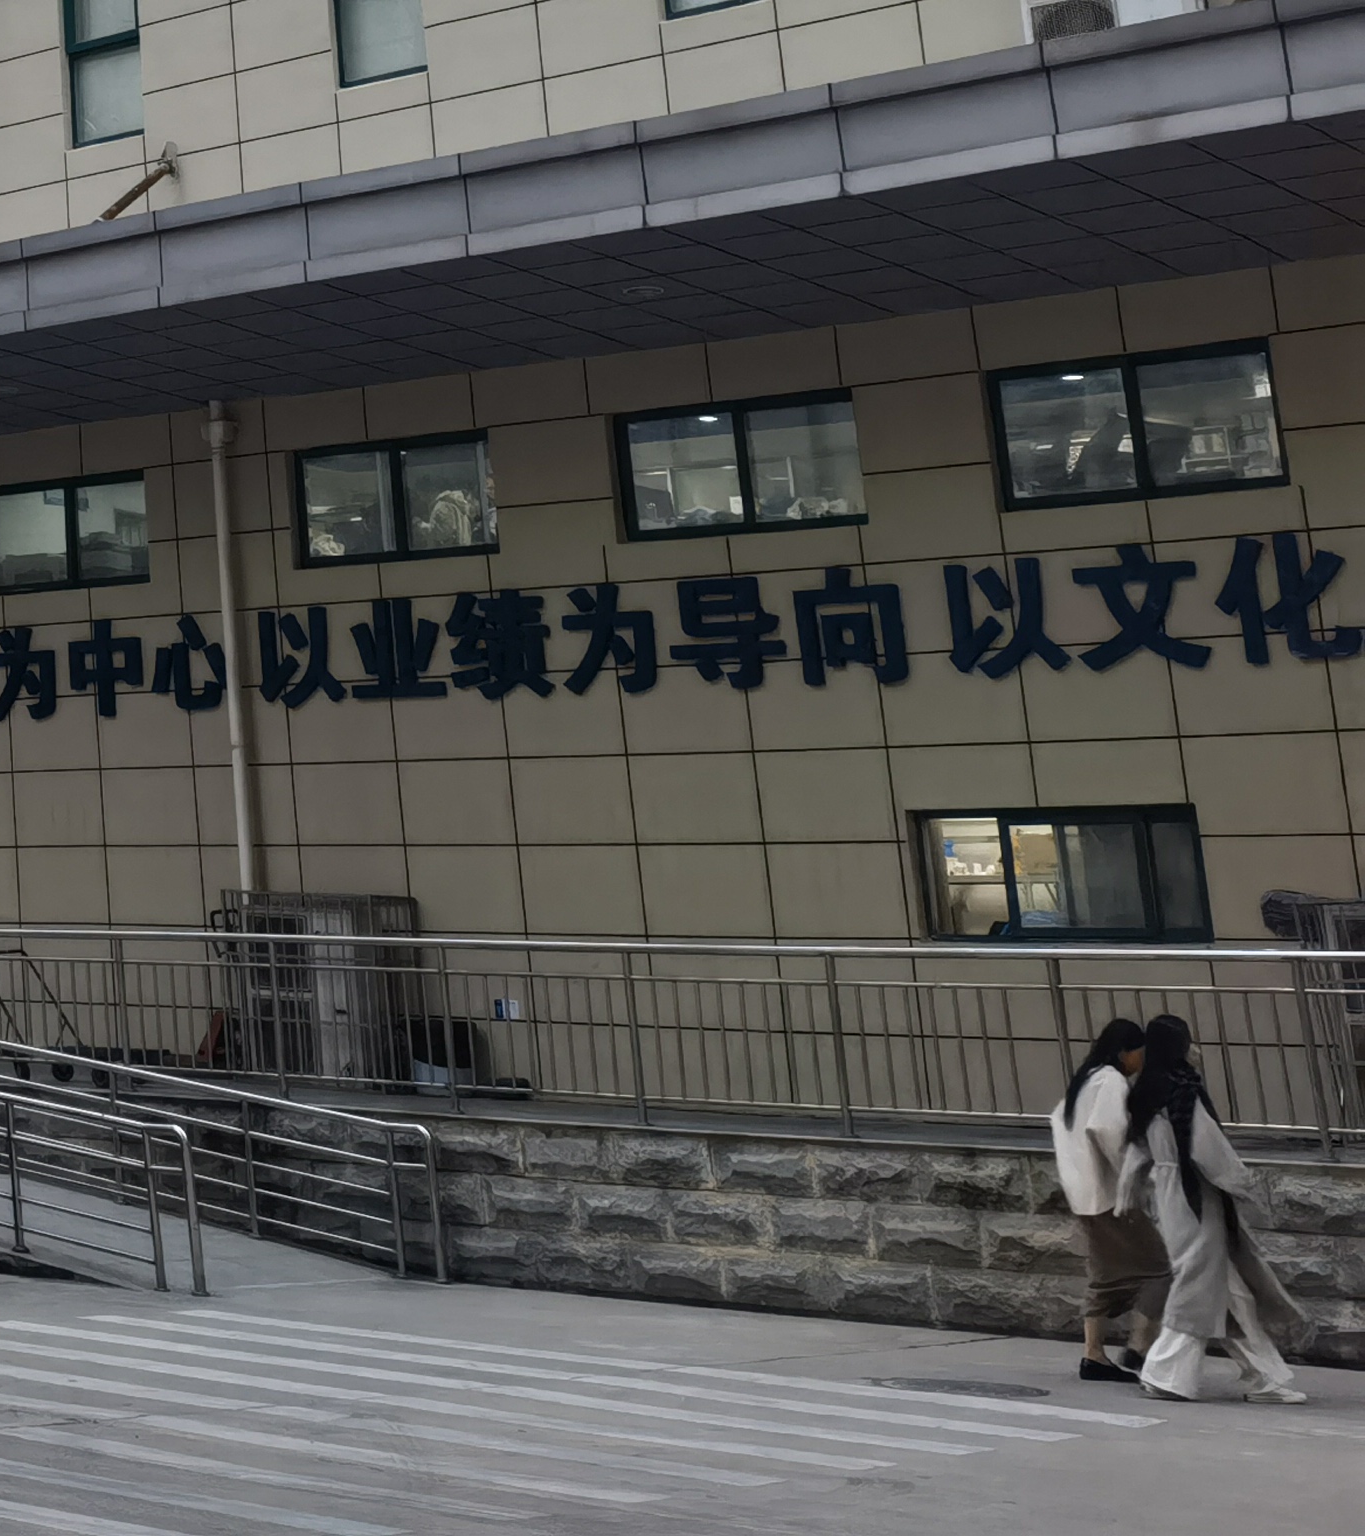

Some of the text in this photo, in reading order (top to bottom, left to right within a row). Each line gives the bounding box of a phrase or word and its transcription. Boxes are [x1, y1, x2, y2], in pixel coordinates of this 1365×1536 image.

[257, 566, 910, 710] 以业绩为导向
[941, 531, 1365, 678] 以文化
